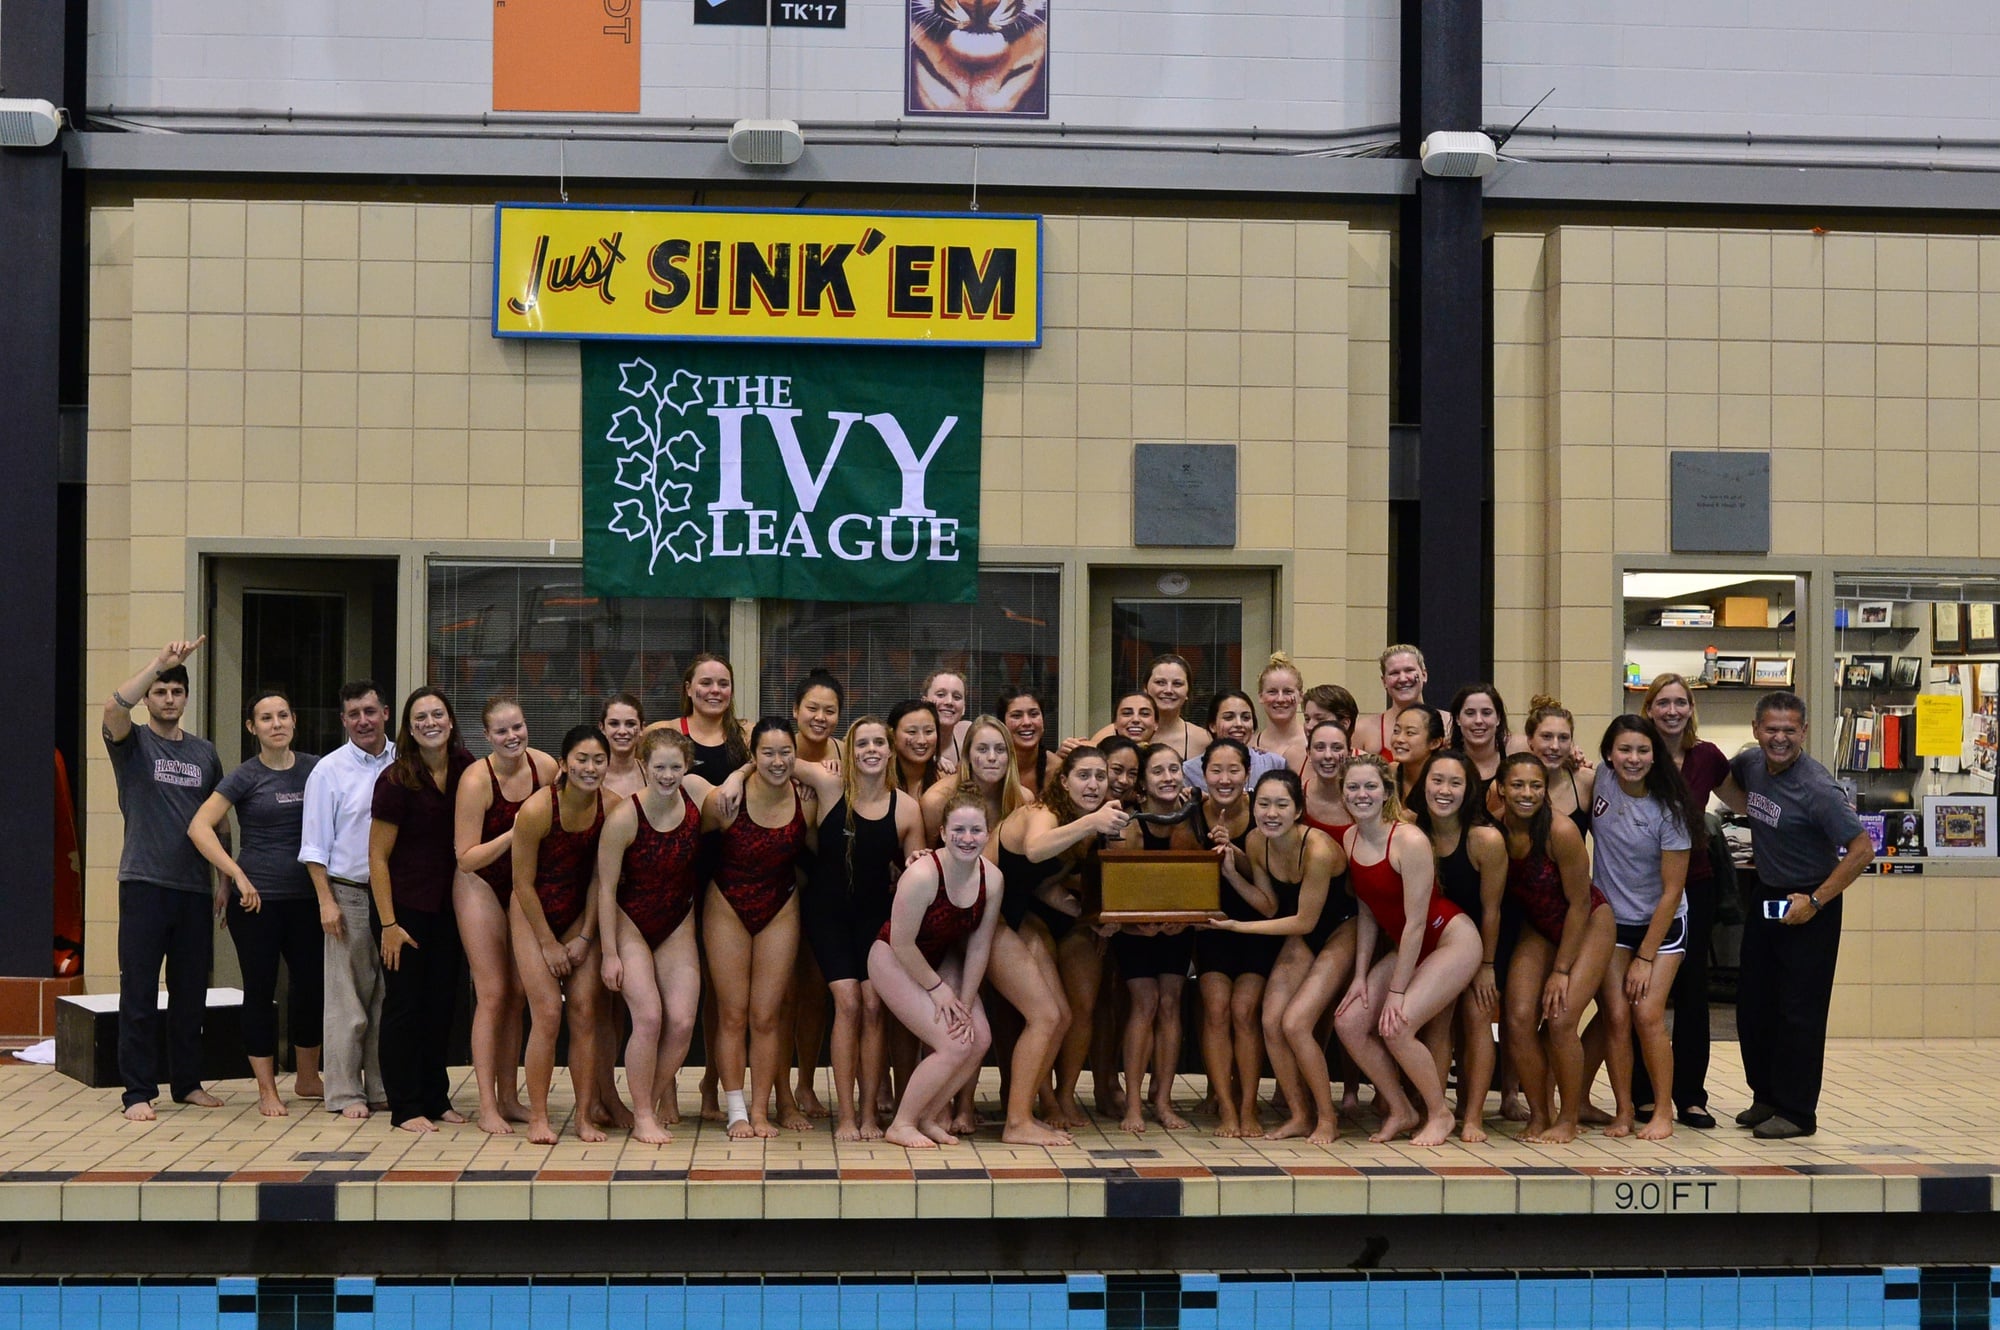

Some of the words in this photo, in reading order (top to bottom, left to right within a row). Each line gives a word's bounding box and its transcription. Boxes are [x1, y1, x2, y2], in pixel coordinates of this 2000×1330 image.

[507, 231, 627, 315] Just
[707, 375, 793, 407] THE
[707, 407, 959, 517] IVY
[707, 510, 960, 562] LEAGUE
[155, 759, 202, 779] HARVARD
[1615, 1182, 1660, 1210] 9.0
[1673, 1182, 1717, 1210] FT
